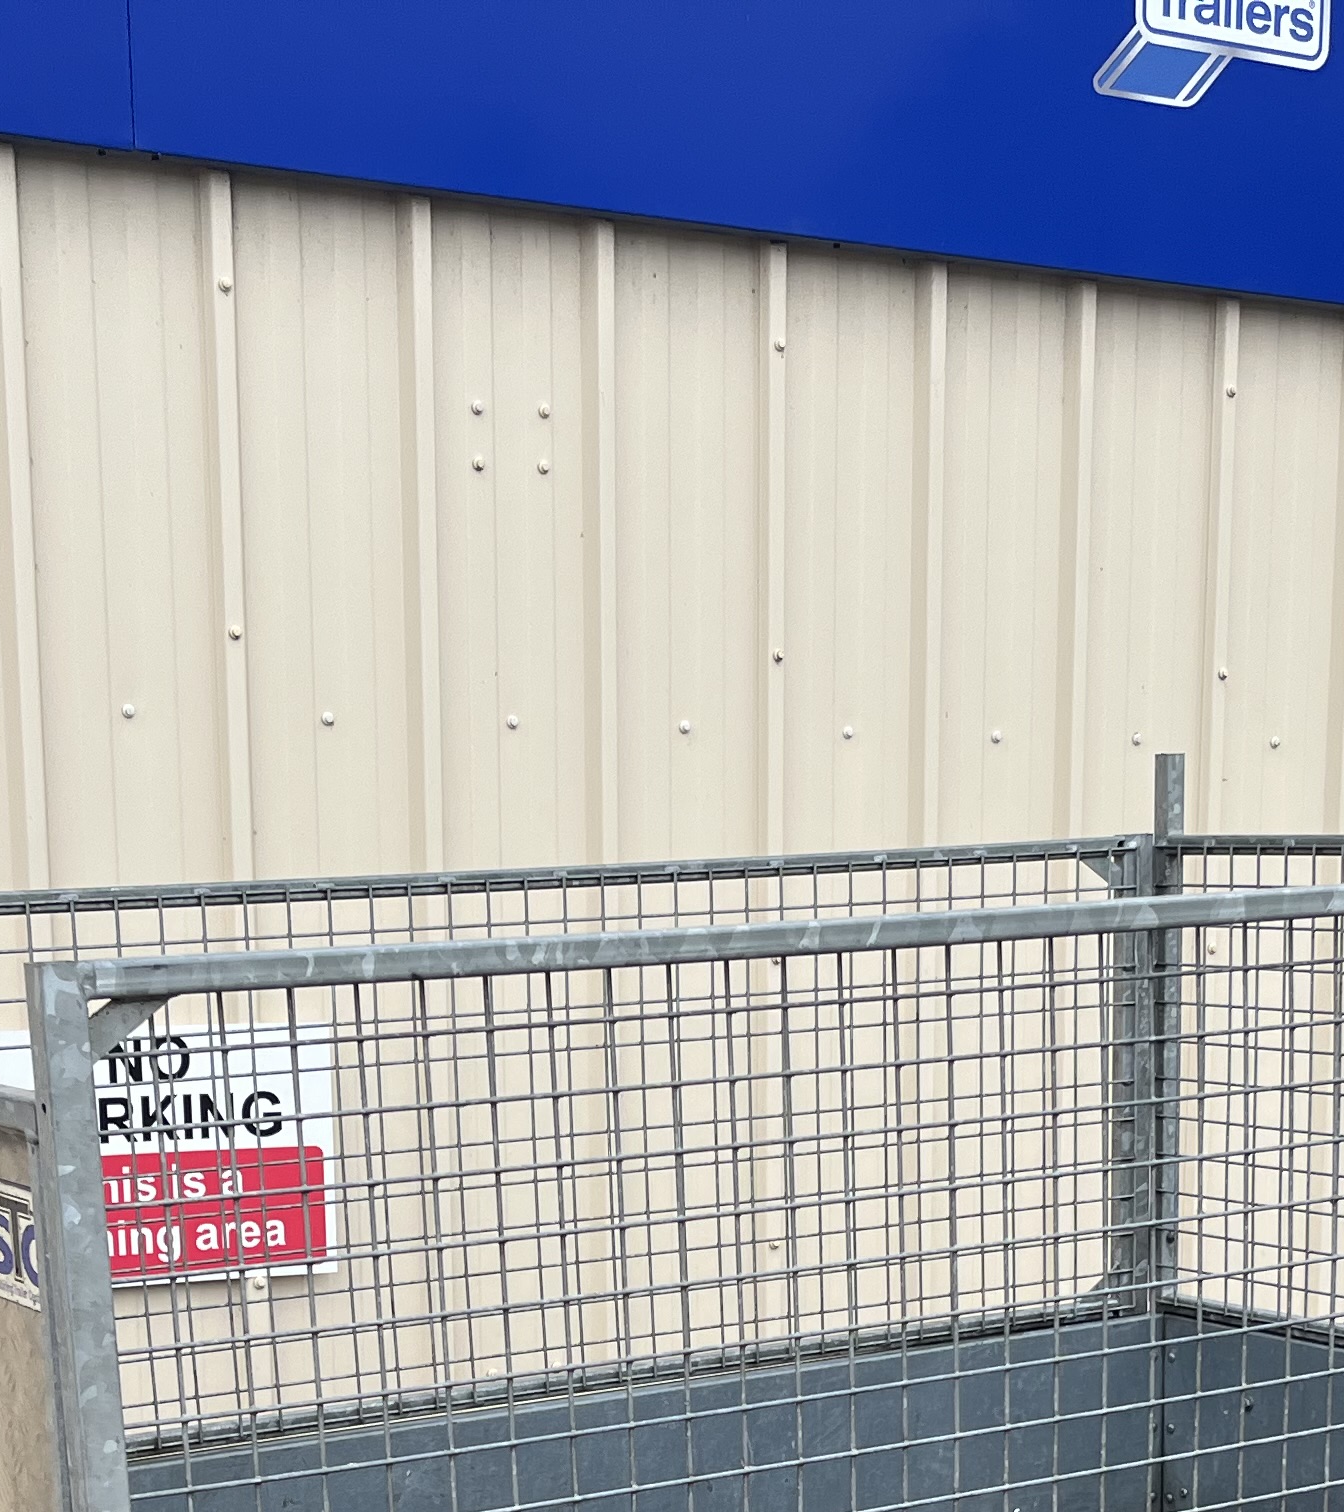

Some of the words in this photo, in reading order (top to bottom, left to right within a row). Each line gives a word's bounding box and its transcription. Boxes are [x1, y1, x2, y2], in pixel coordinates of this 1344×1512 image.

[108, 1036, 190, 1084] NO
[98, 1090, 283, 1144] RKING
[171, 1163, 206, 1199] is
[221, 1168, 244, 1198] a
[195, 1219, 287, 1251] area
